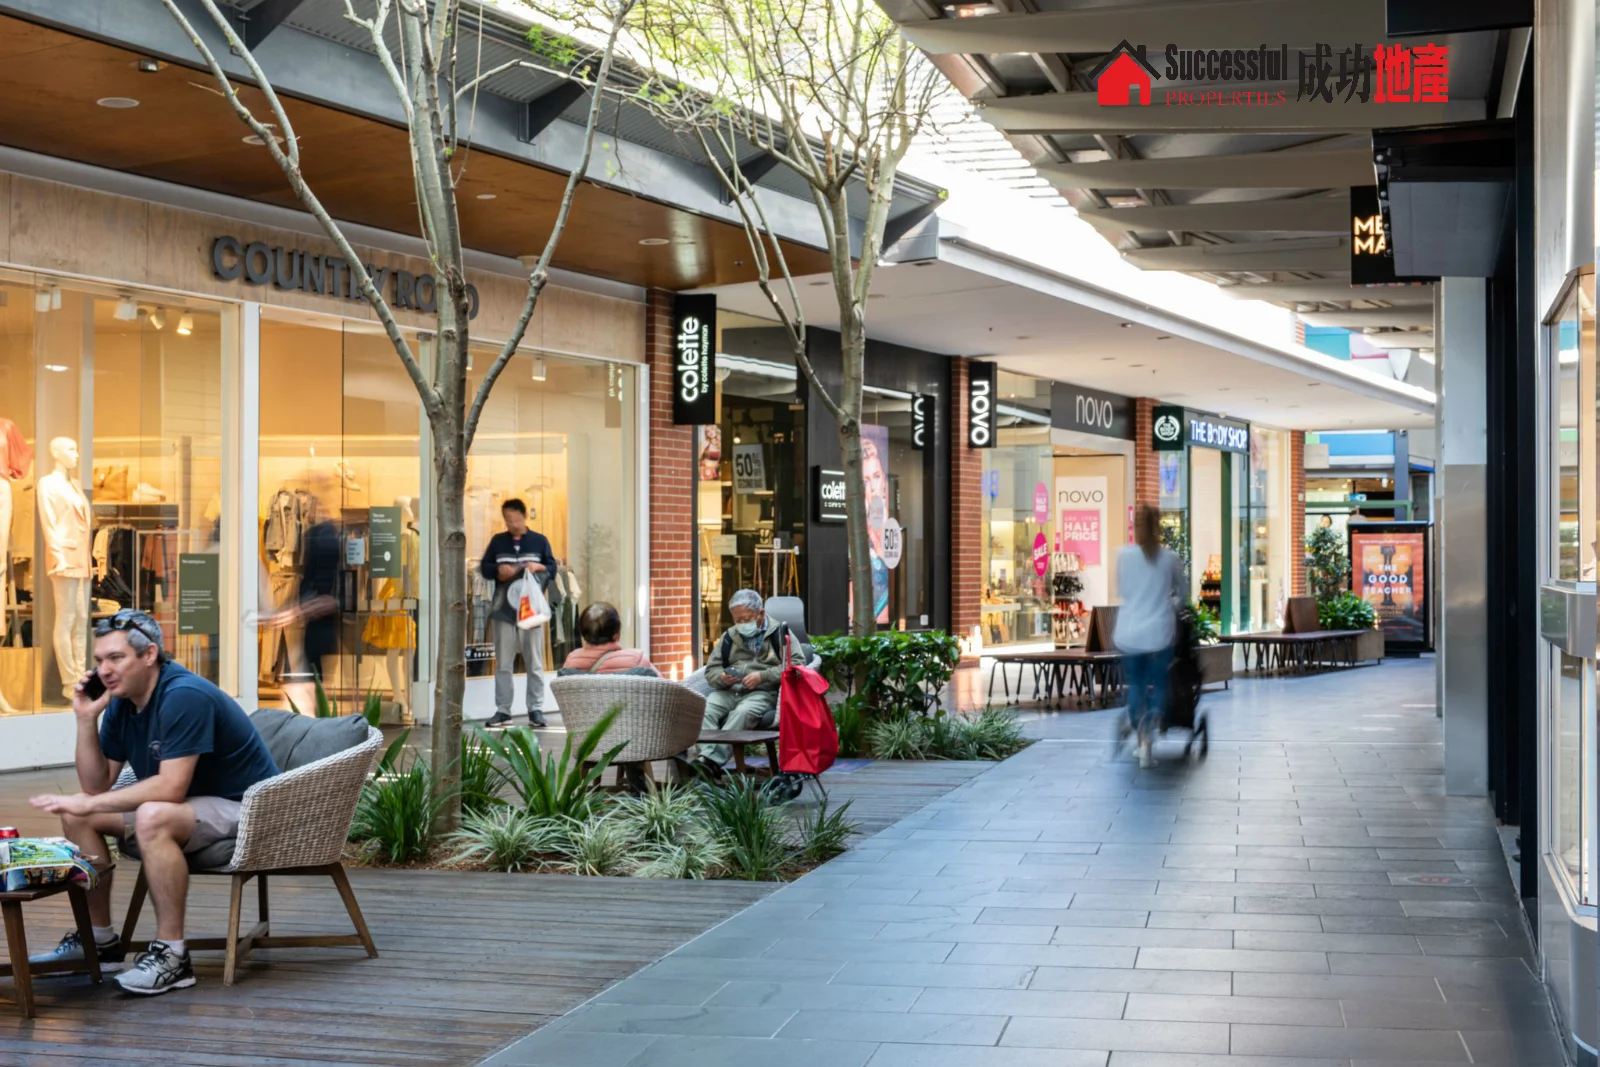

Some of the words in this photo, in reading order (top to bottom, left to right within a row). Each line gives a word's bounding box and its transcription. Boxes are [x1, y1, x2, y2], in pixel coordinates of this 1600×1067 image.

[677, 316, 700, 402] colette
[701, 383, 709, 393] by
[971, 380, 990, 446] novo
[1075, 394, 1113, 429] novo
[1190, 420, 1206, 442] THE
[1228, 426, 1248, 449] SHOP
[1058, 490, 1104, 503] novo
[1064, 522, 1098, 531] HALF
[1064, 531, 1098, 541] PRICE
[1378, 564, 1398, 572] THE
[1368, 575, 1408, 584] GOOD
[1363, 586, 1413, 595] TEACHER
